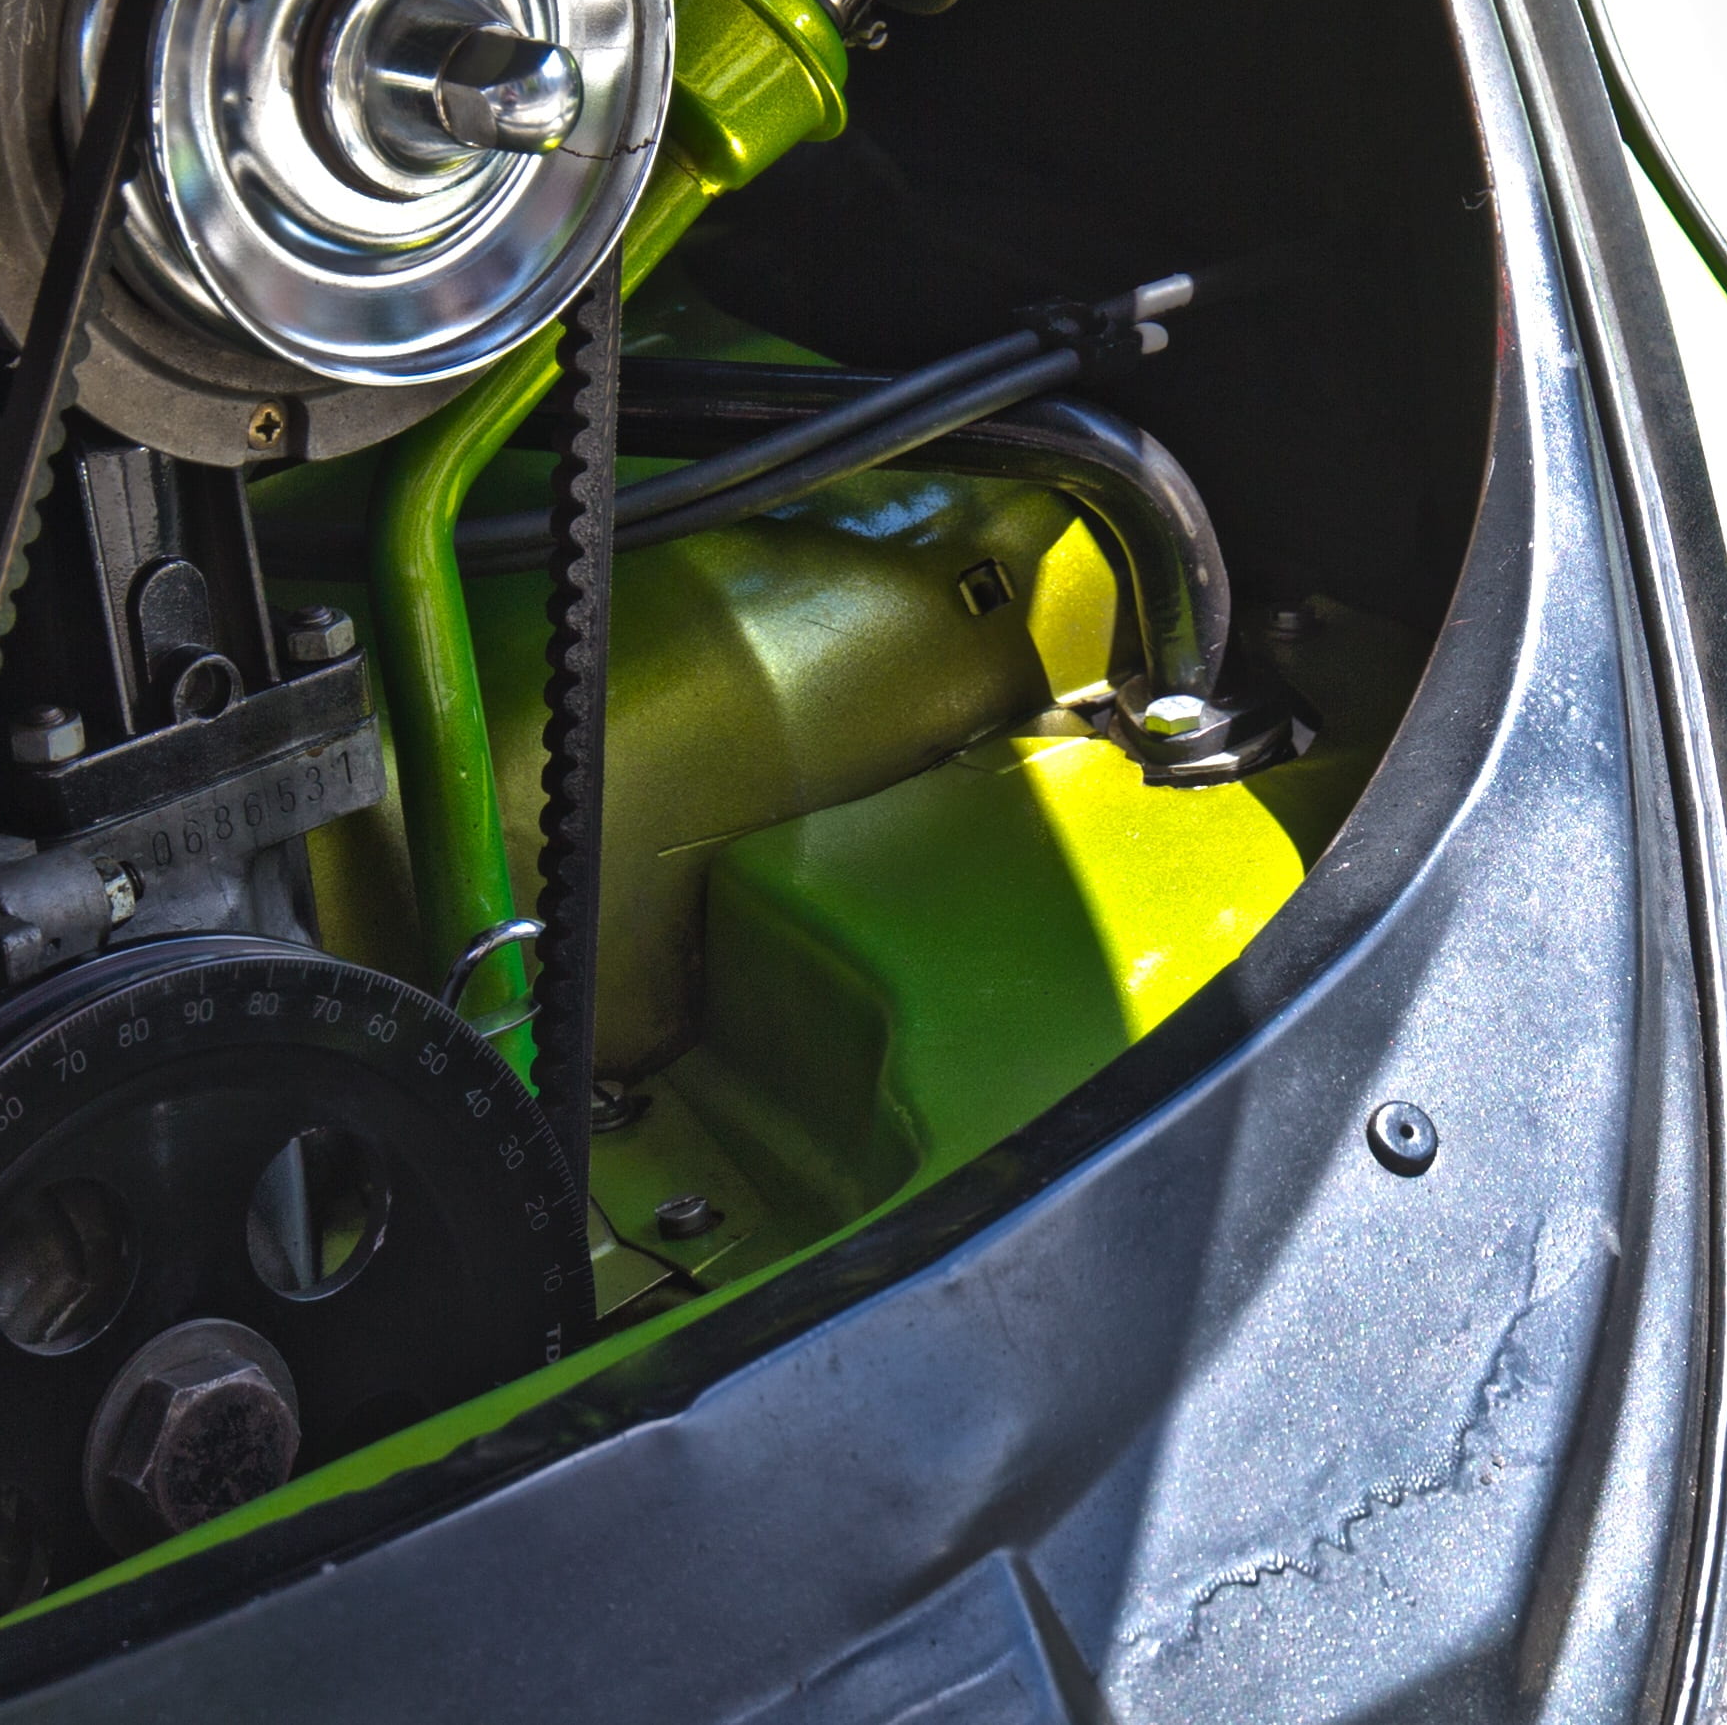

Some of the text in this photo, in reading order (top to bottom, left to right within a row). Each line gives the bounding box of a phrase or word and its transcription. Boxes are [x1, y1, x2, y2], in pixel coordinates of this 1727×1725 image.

[151, 751, 354, 867] 0686531
[52, 1047, 88, 1083] 70
[117, 1014, 150, 1048] 80
[183, 995, 214, 1025] 90
[246, 991, 279, 1018] 80
[313, 995, 342, 1023] 70
[366, 1013, 399, 1044] 60
[418, 1045, 450, 1077] 50
[463, 1087, 491, 1119] 40
[499, 1136, 525, 1170] 30
[525, 1194, 552, 1231] 20
[542, 1263, 563, 1294] 10
